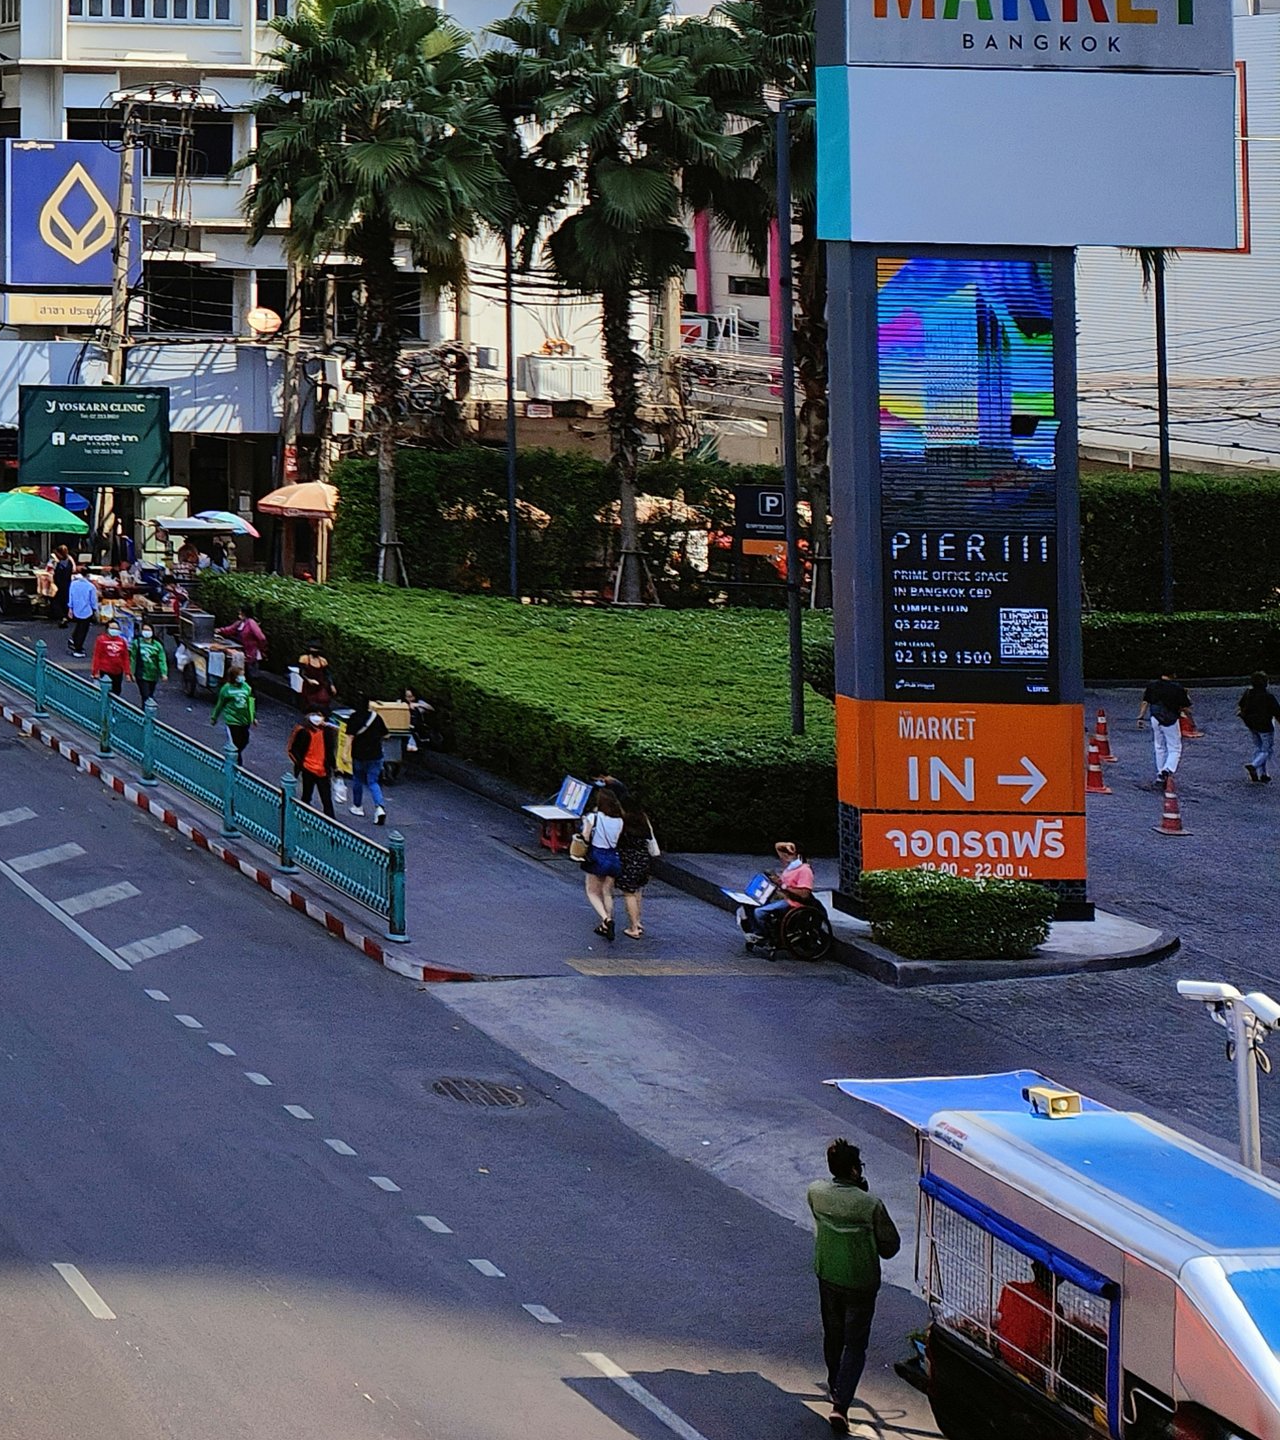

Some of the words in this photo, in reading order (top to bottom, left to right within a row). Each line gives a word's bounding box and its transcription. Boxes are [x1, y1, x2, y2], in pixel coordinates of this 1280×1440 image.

[962, 34, 1121, 53] BANGKOK
[58, 403, 108, 412] YOSKARN
[109, 403, 146, 413] CLINIC
[122, 433, 139, 442] Inn
[766, 496, 779, 512] P
[892, 532, 986, 561] PIER
[893, 570, 929, 581] PRIME
[932, 571, 971, 582] OFFICE
[975, 572, 1009, 582] SPACE
[893, 587, 907, 597] IN
[910, 587, 966, 598] BANGKOK
[969, 588, 992, 598] CBD
[913, 620, 940, 630] 2022
[895, 650, 914, 663] 02
[921, 650, 948, 664] 119
[955, 651, 992, 664] 1500
[898, 716, 977, 741] MARKET
[908, 756, 975, 801] IN
[885, 819, 1065, 858] จอดรถฟรี
